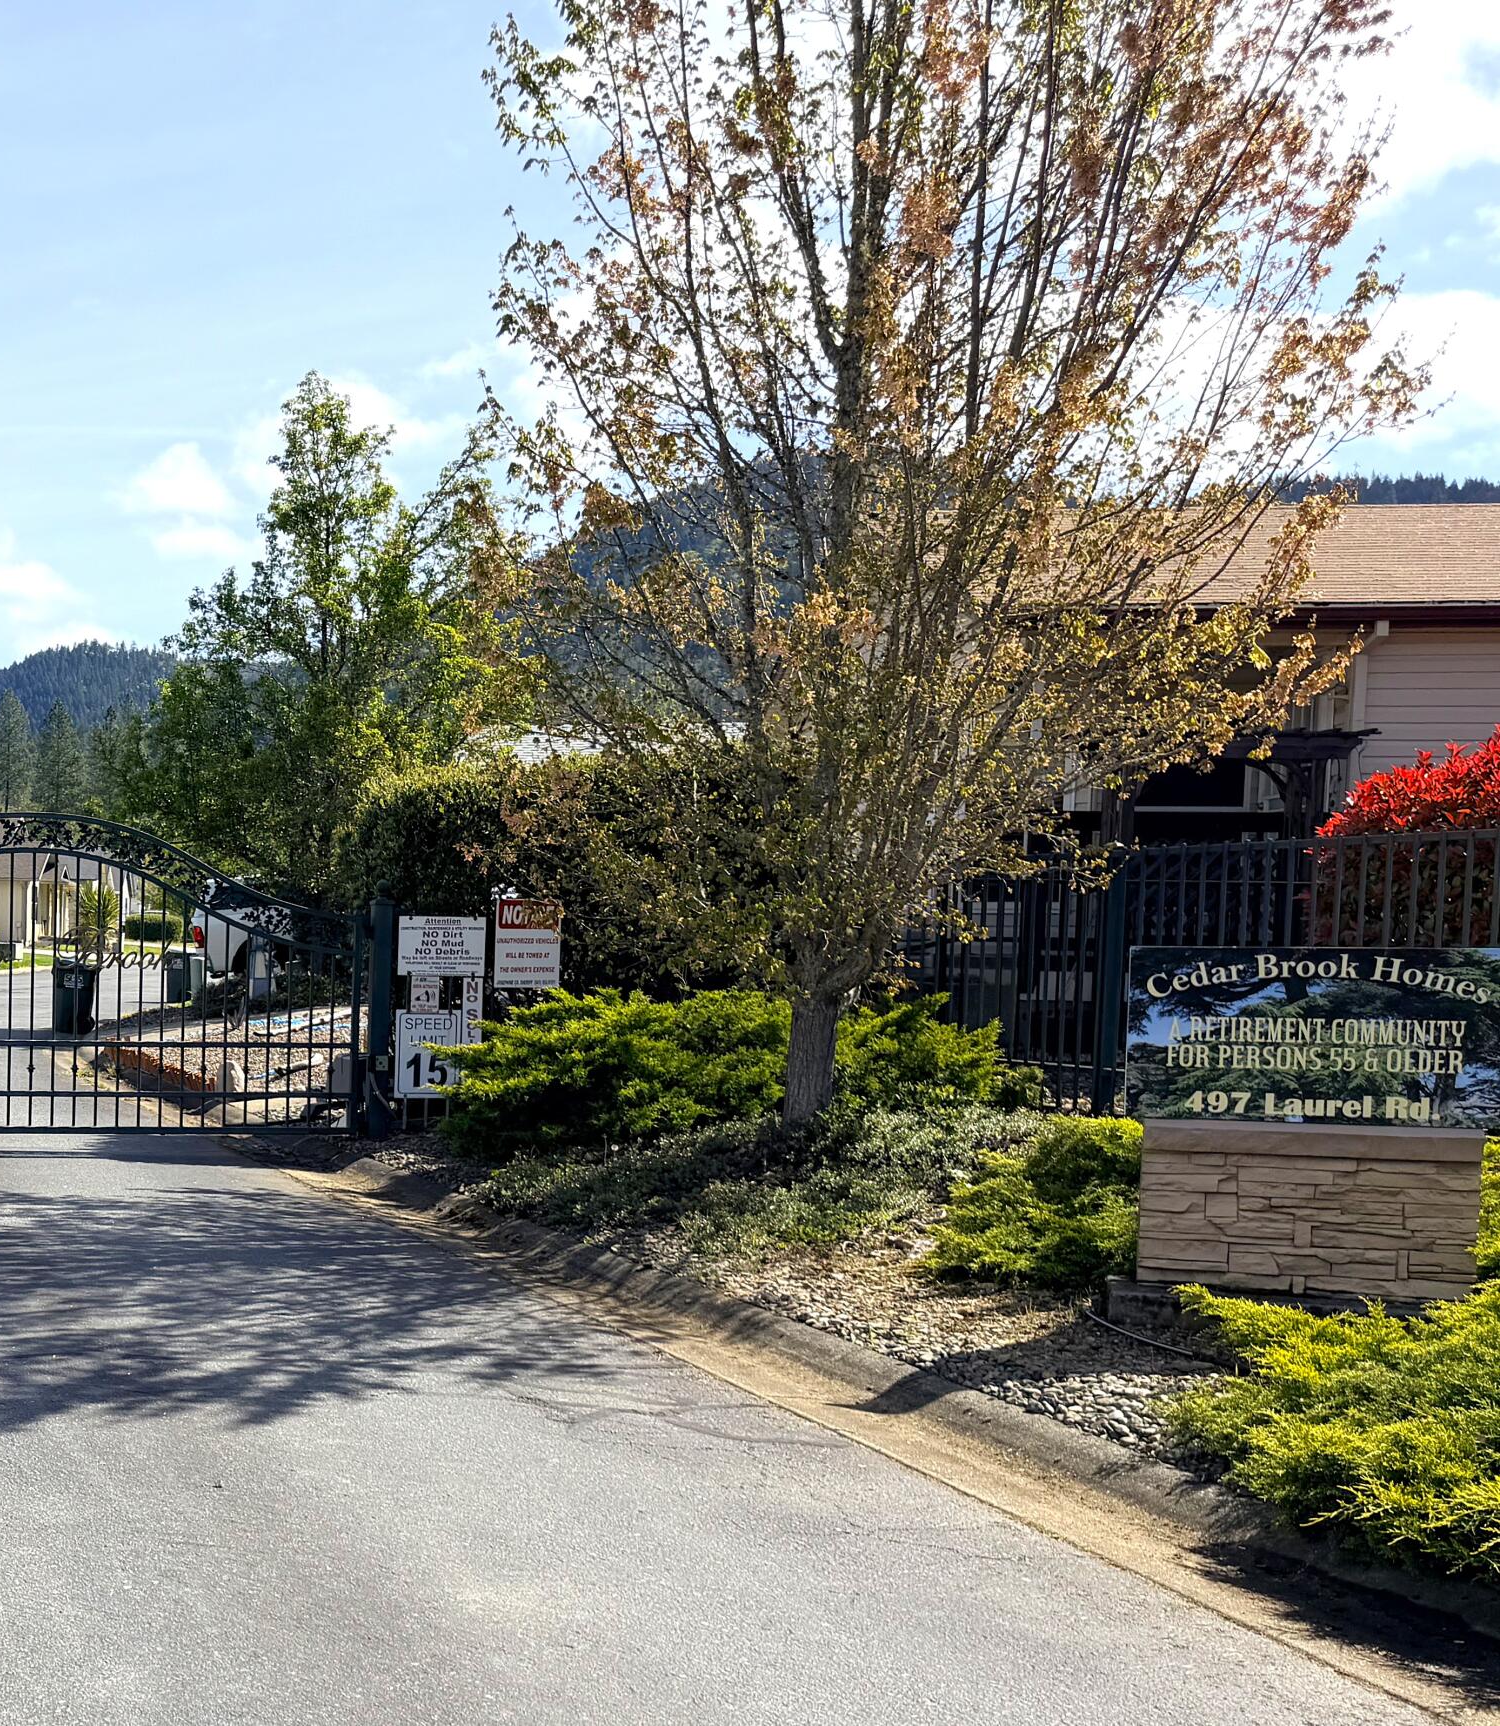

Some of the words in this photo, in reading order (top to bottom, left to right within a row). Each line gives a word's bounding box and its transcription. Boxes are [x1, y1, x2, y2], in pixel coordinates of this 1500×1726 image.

[58, 925, 178, 971] Brook
[466, 981, 479, 1003] NO
[1146, 960, 1247, 998] Cedar
[1254, 953, 1360, 980] Brook
[1369, 955, 1492, 1006] Homes
[405, 1018, 453, 1030] SPEED
[1167, 1016, 1182, 1042] A
[1189, 1016, 1326, 1045] RETIREMENT
[1330, 1018, 1467, 1047] COMMUNITY
[406, 1053, 447, 1088] 15
[1166, 1044, 1210, 1068] FOR
[1218, 1045, 1322, 1071] PERSONS
[1329, 1048, 1356, 1072] 55
[1363, 1049, 1379, 1073] &
[1386, 1049, 1463, 1075] OLDER
[1185, 1090, 1251, 1114] 497
[1264, 1092, 1372, 1119] Laurel
[1385, 1096, 1441, 1121] Rd.
